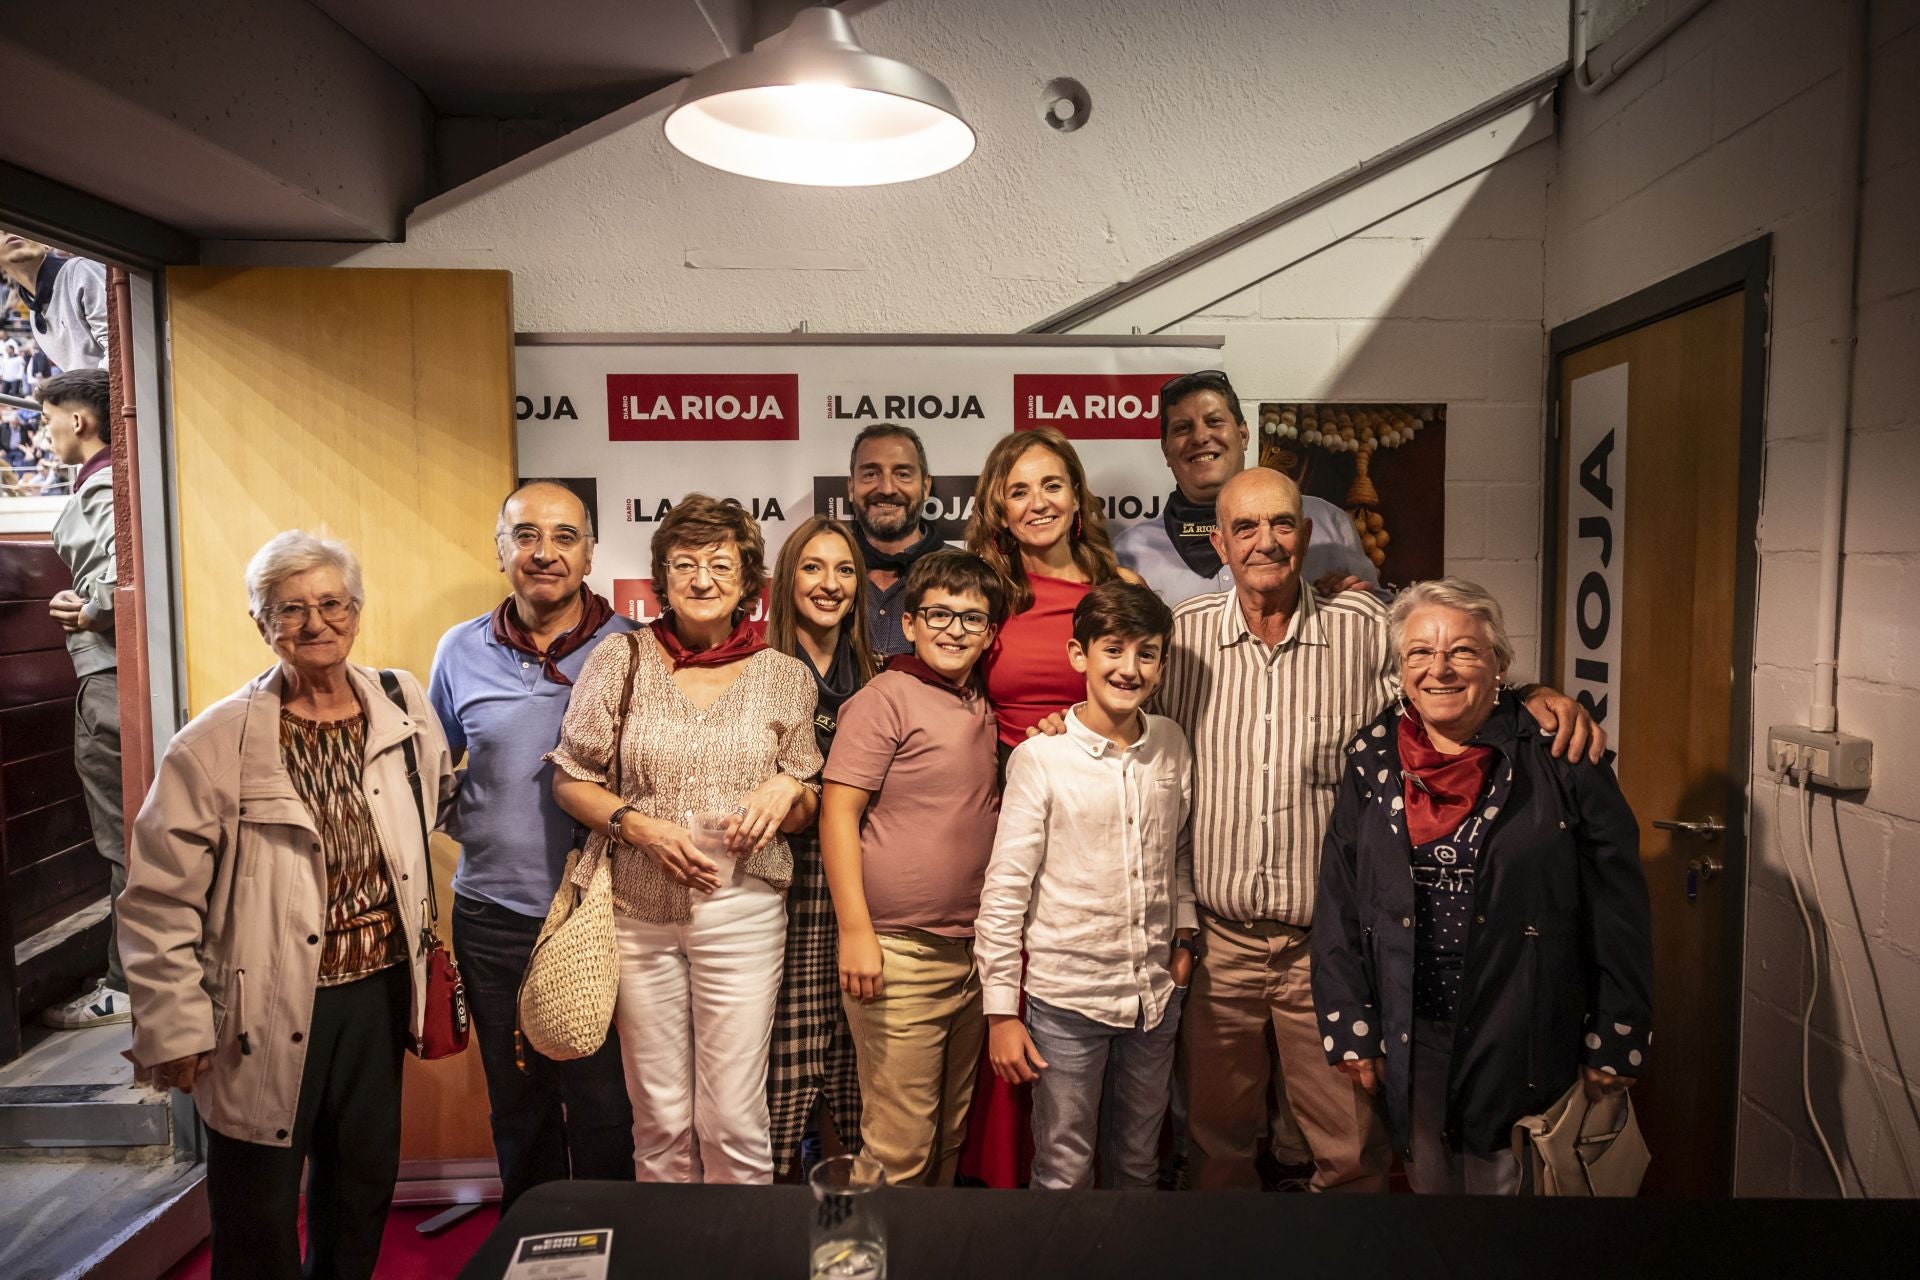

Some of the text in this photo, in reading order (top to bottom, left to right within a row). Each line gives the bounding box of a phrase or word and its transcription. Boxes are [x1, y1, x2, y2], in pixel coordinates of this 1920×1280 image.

[516, 395, 578, 420] OJA
[630, 394, 784, 421] LA RIOJA
[834, 394, 986, 420] LA RIOJA
[1035, 394, 1160, 420] LA RIOJ
